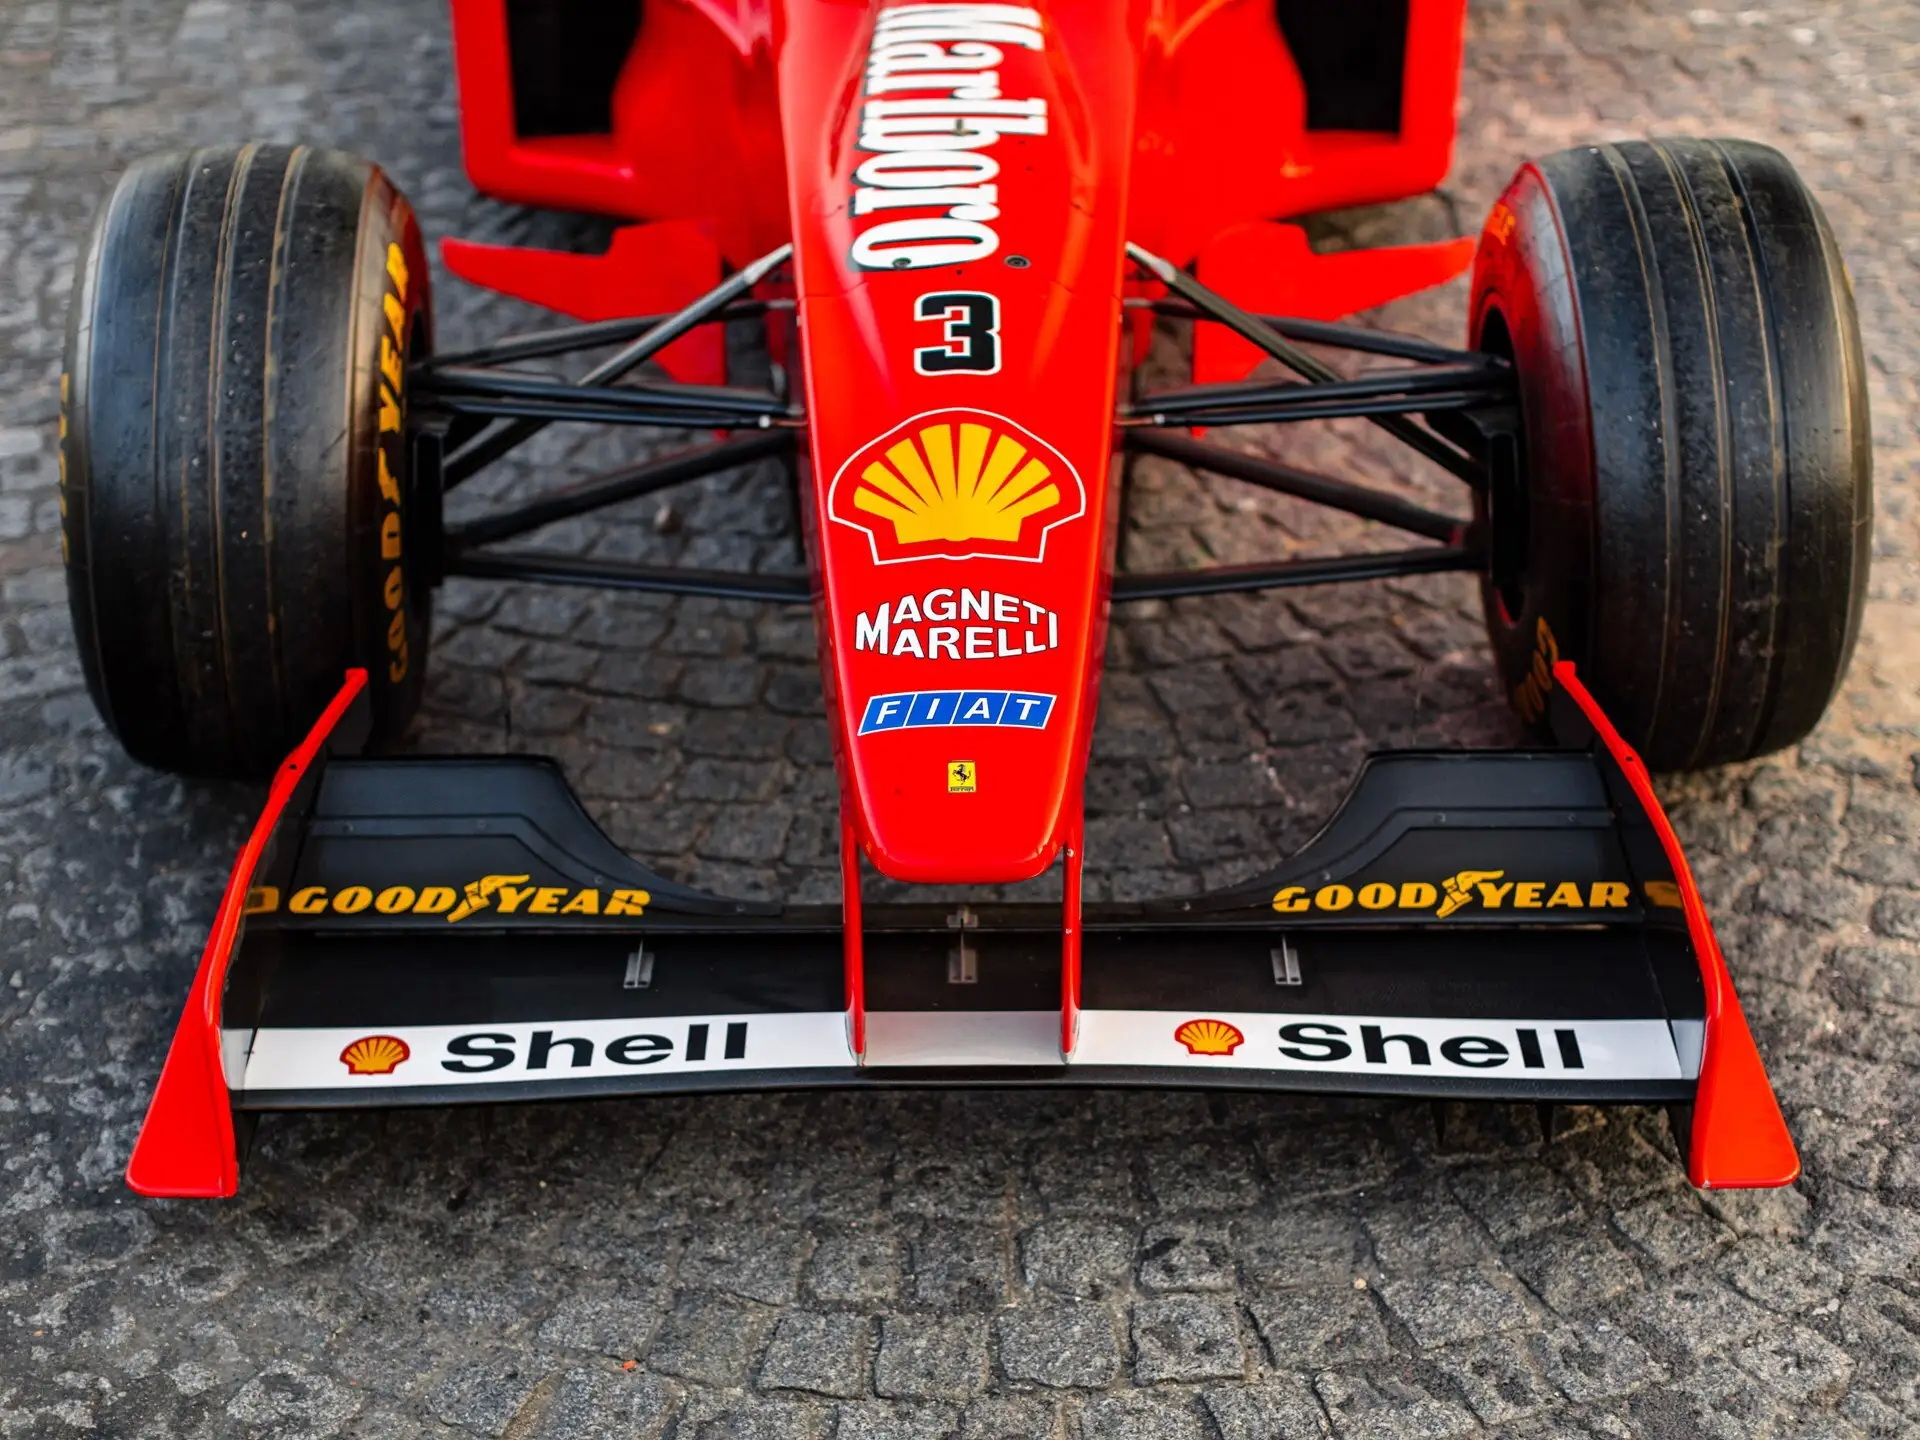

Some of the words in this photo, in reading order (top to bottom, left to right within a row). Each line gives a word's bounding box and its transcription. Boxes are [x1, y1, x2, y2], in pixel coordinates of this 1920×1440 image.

[850, 3, 1048, 270] Marlboro
[914, 291, 1001, 376] 3
[855, 588, 1058, 647] MAGNETI
[855, 606, 1058, 660] MARELLI
[875, 697, 1041, 725] FIAT
[441, 1022, 748, 1073] Shell
[1278, 1022, 1585, 1069] Shell
